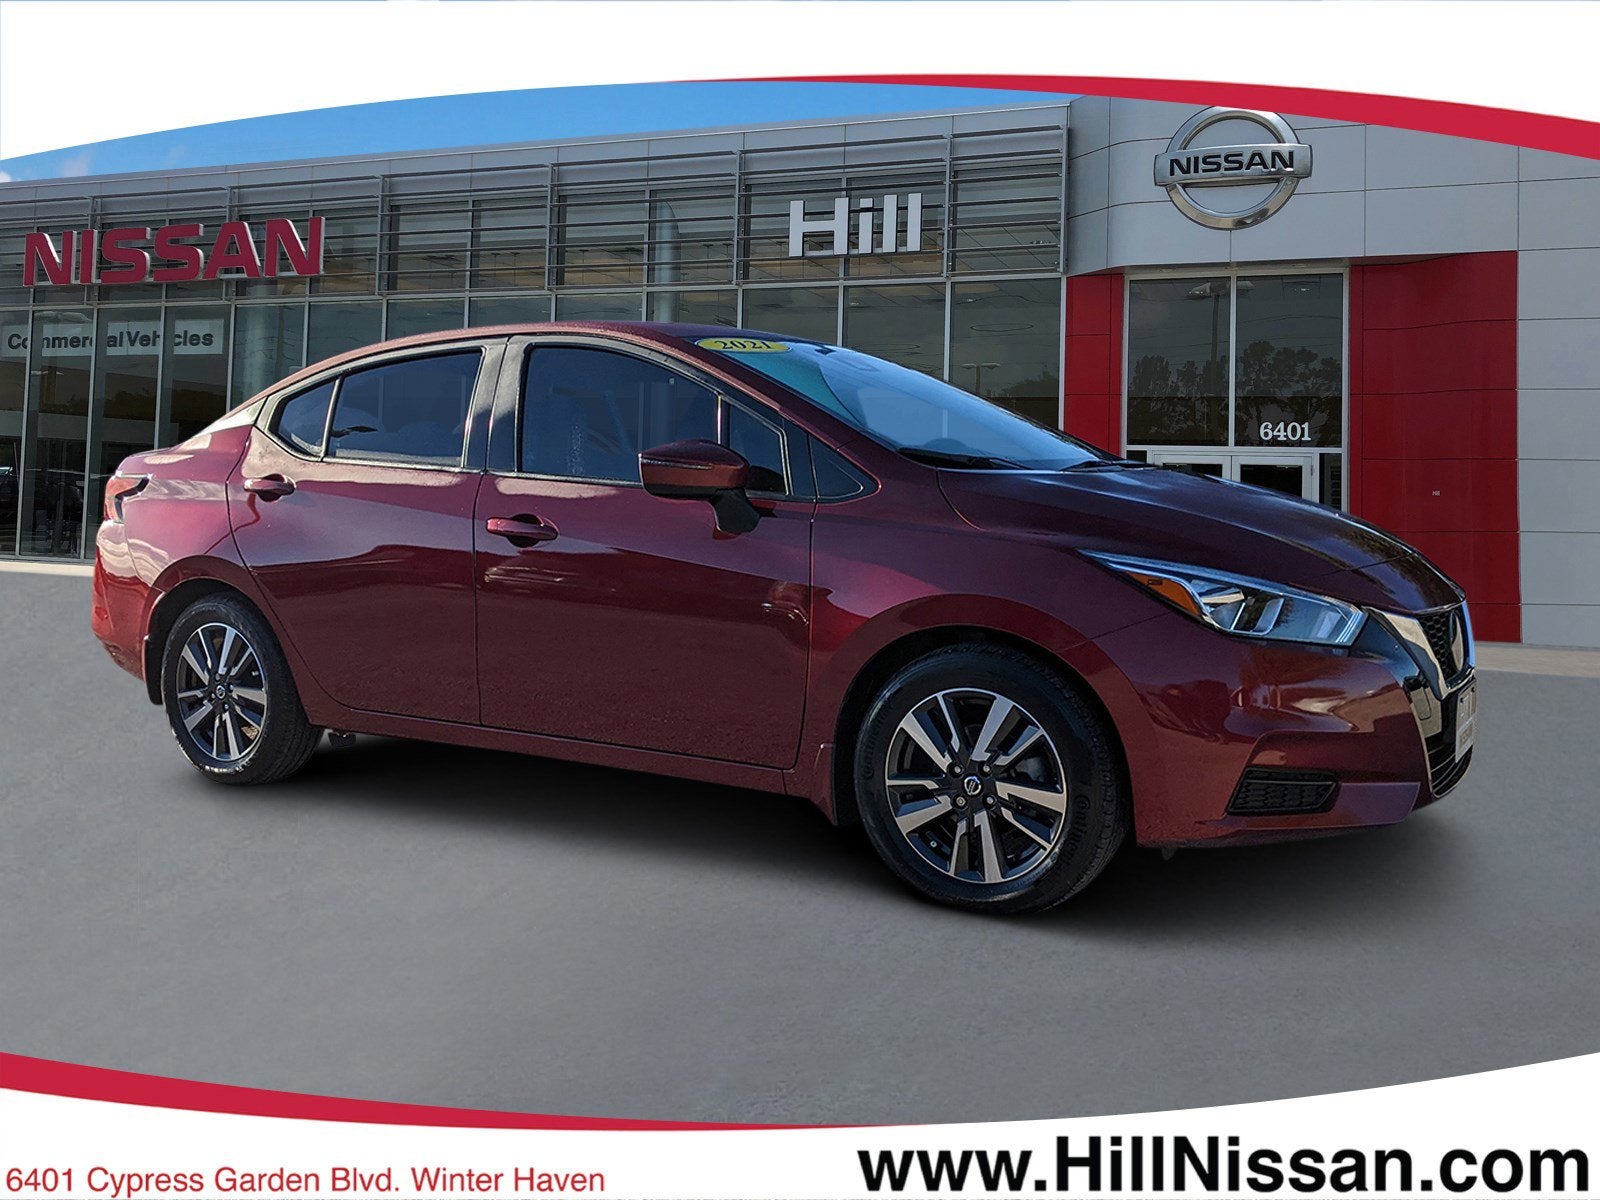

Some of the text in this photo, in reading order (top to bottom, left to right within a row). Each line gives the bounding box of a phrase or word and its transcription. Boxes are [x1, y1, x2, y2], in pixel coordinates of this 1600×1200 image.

[1169, 151, 1294, 176] NISSAN
[789, 193, 922, 257] Hill
[23, 216, 325, 287] NISSAN
[127, 330, 214, 347] Vehcles
[714, 340, 774, 350] 2021
[1259, 422, 1312, 441] 6401
